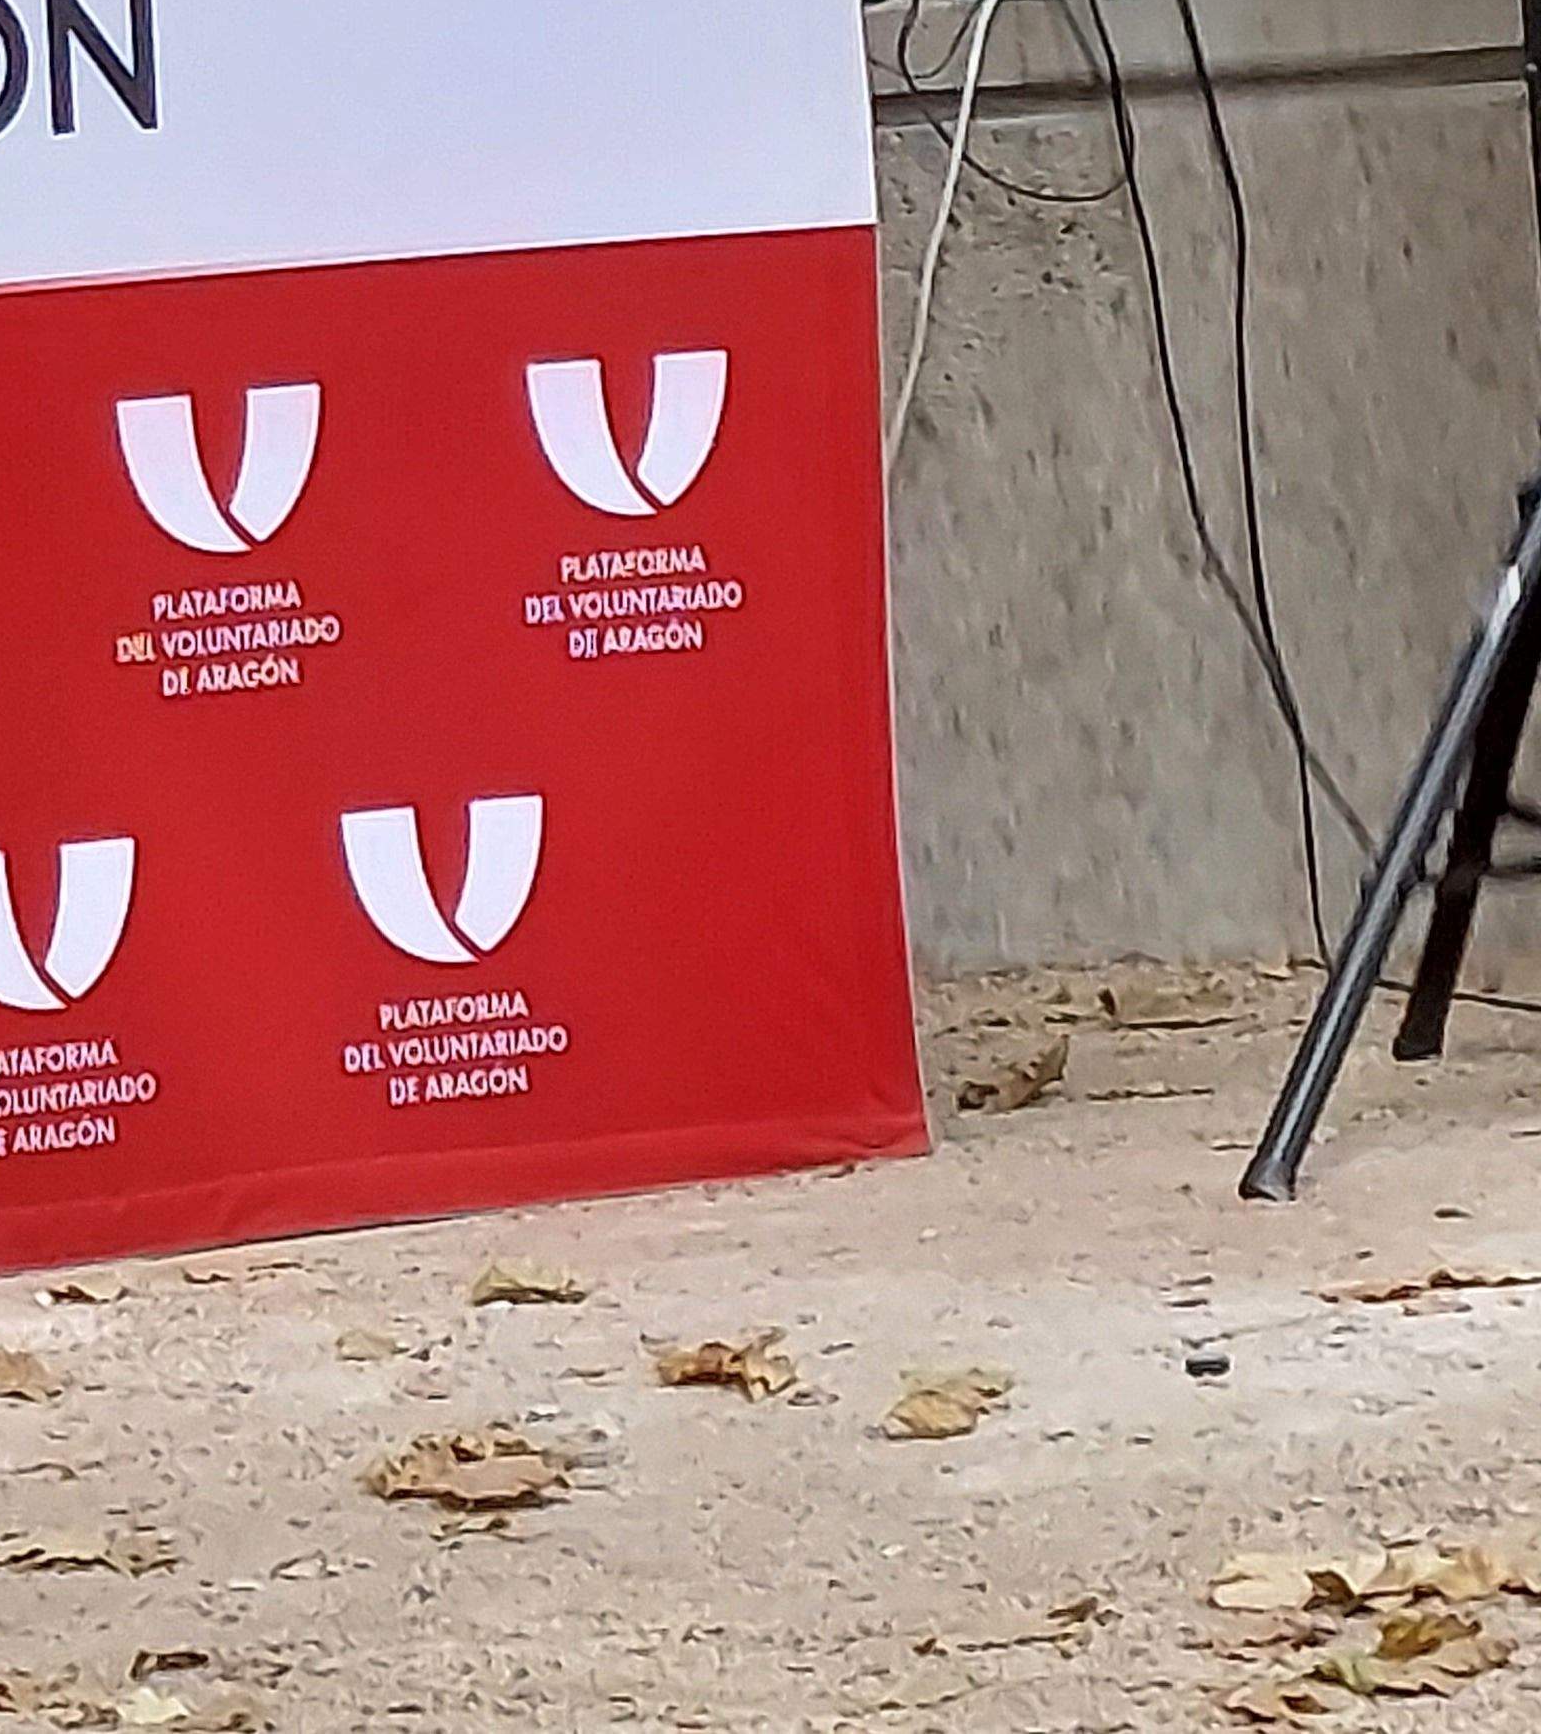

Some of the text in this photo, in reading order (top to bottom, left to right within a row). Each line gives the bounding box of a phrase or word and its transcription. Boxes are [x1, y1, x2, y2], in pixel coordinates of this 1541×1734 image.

[560, 544, 707, 584] PLATAFORMA
[151, 580, 303, 622] PLATAFORMA
[524, 580, 743, 625] DEL VOLUNTARIADO
[115, 615, 341, 664] DEL VOLUNTARIADO
[568, 617, 704, 660] DE ARAGÓN
[161, 652, 300, 698] DE ARAGÓN
[378, 990, 530, 1031] PLATAFORMA
[343, 1024, 569, 1074] DEL VOLUNTARIADO
[388, 1065, 530, 1106] DE ARAGÓN
[11, 1112, 117, 1154] ARAGÓN
